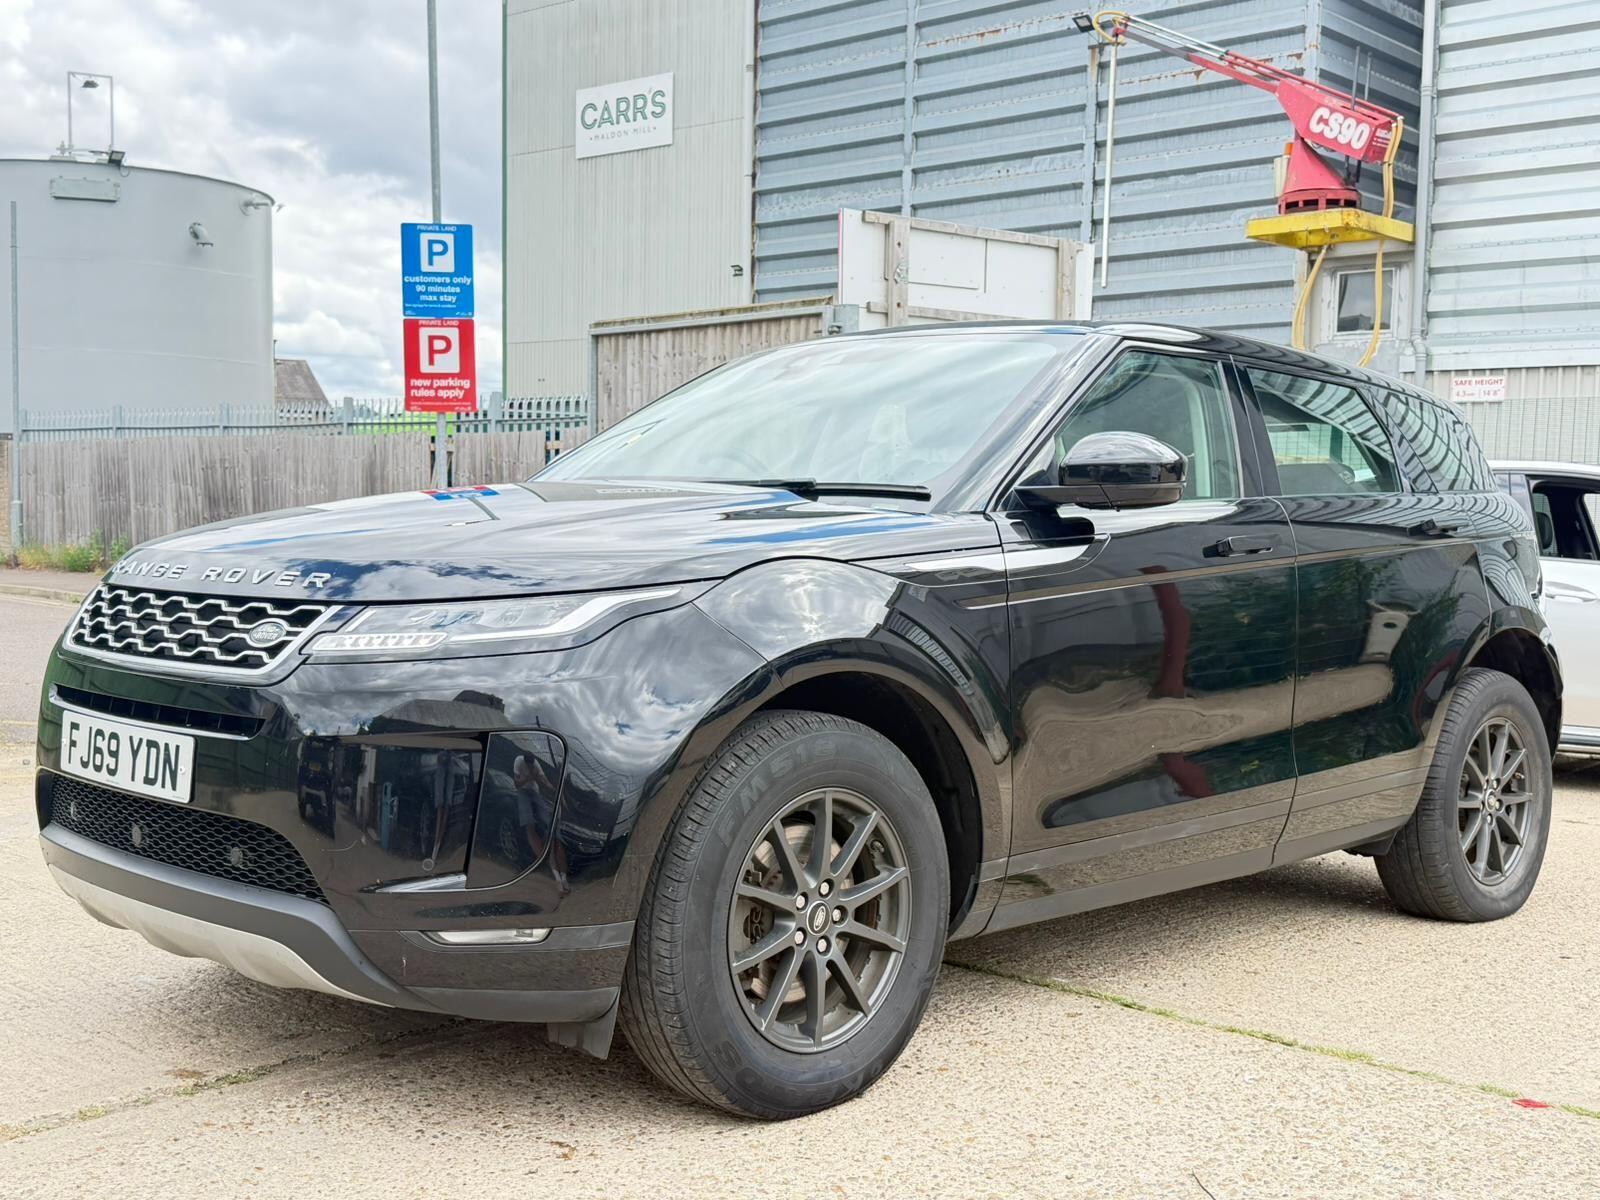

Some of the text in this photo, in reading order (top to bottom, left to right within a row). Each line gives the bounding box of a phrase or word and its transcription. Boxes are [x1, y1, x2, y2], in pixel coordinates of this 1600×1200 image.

[581, 87, 667, 130] CARR'S
[594, 126, 651, 140] MALDON MILL
[1309, 107, 1371, 150] CS90
[428, 239, 449, 266] P
[404, 275, 472, 286] customers only
[415, 285, 461, 293] 90 minutes
[439, 294, 457, 303] stay
[428, 335, 452, 366] P
[410, 377, 471, 389] new parking
[1474, 378, 1504, 386] HEIGHT
[410, 387, 465, 399] rules apply
[200, 567, 332, 589] ROVER
[68, 721, 180, 792] FJ69 YDN
